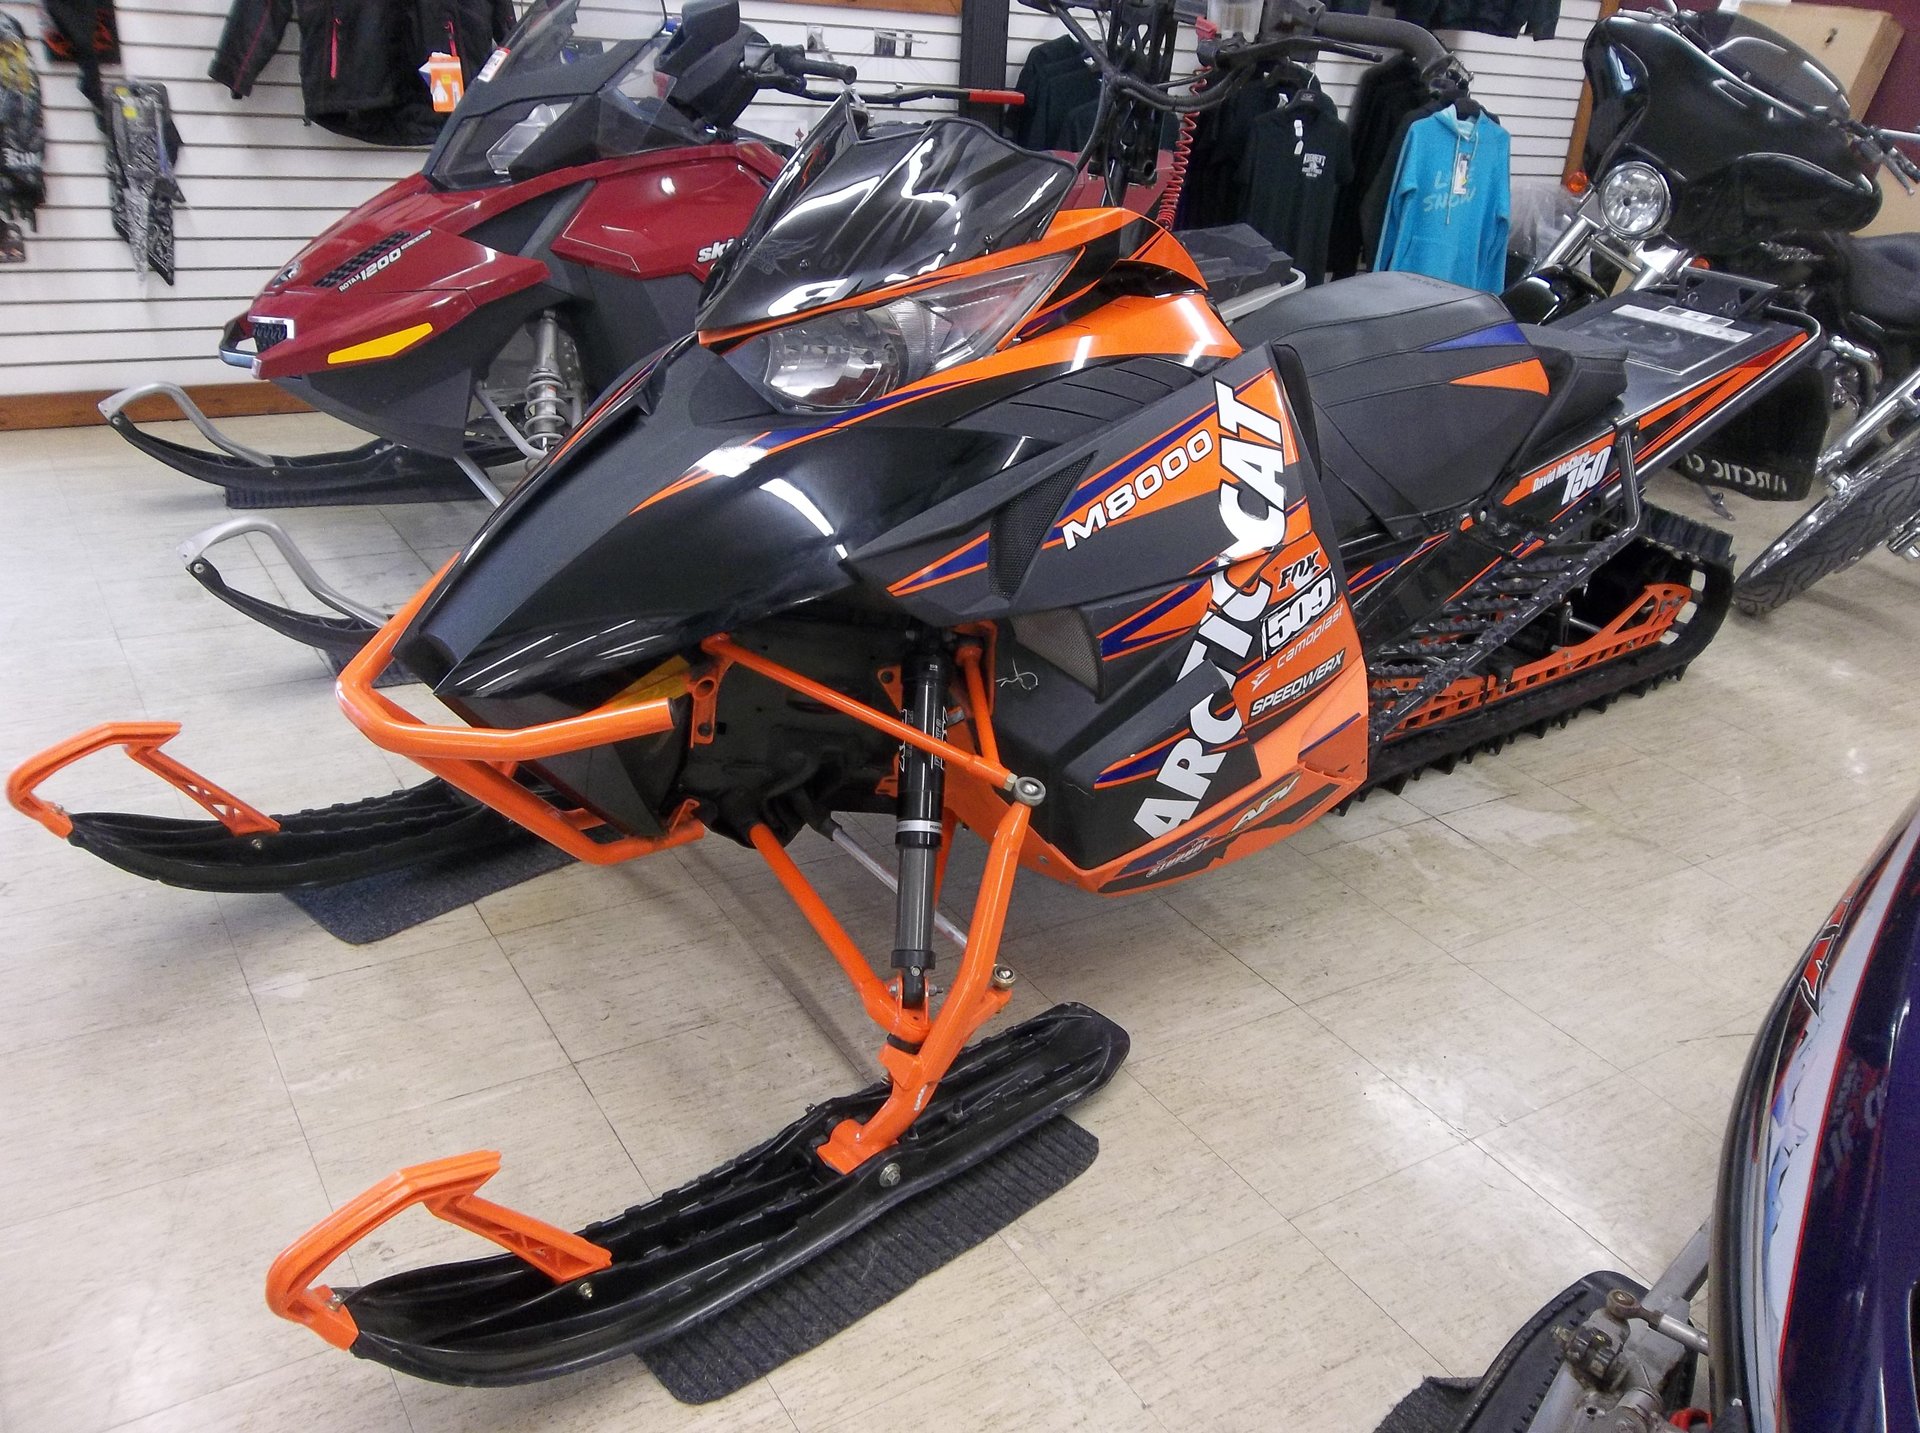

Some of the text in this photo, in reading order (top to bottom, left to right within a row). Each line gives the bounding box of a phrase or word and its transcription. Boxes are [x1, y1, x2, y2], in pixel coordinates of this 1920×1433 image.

[339, 248, 401, 291] ROTAX 1200
[1062, 430, 1214, 550] M8000
[1561, 446, 1611, 505] 150
[1278, 548, 1321, 591] FOX
[1133, 567, 1272, 838] ARCTIC
[1214, 377, 1286, 562] CAT
[1267, 577, 1331, 648] 509
[1277, 603, 1343, 669] camoplast
[1250, 649, 1344, 717] SPEEDWERX
